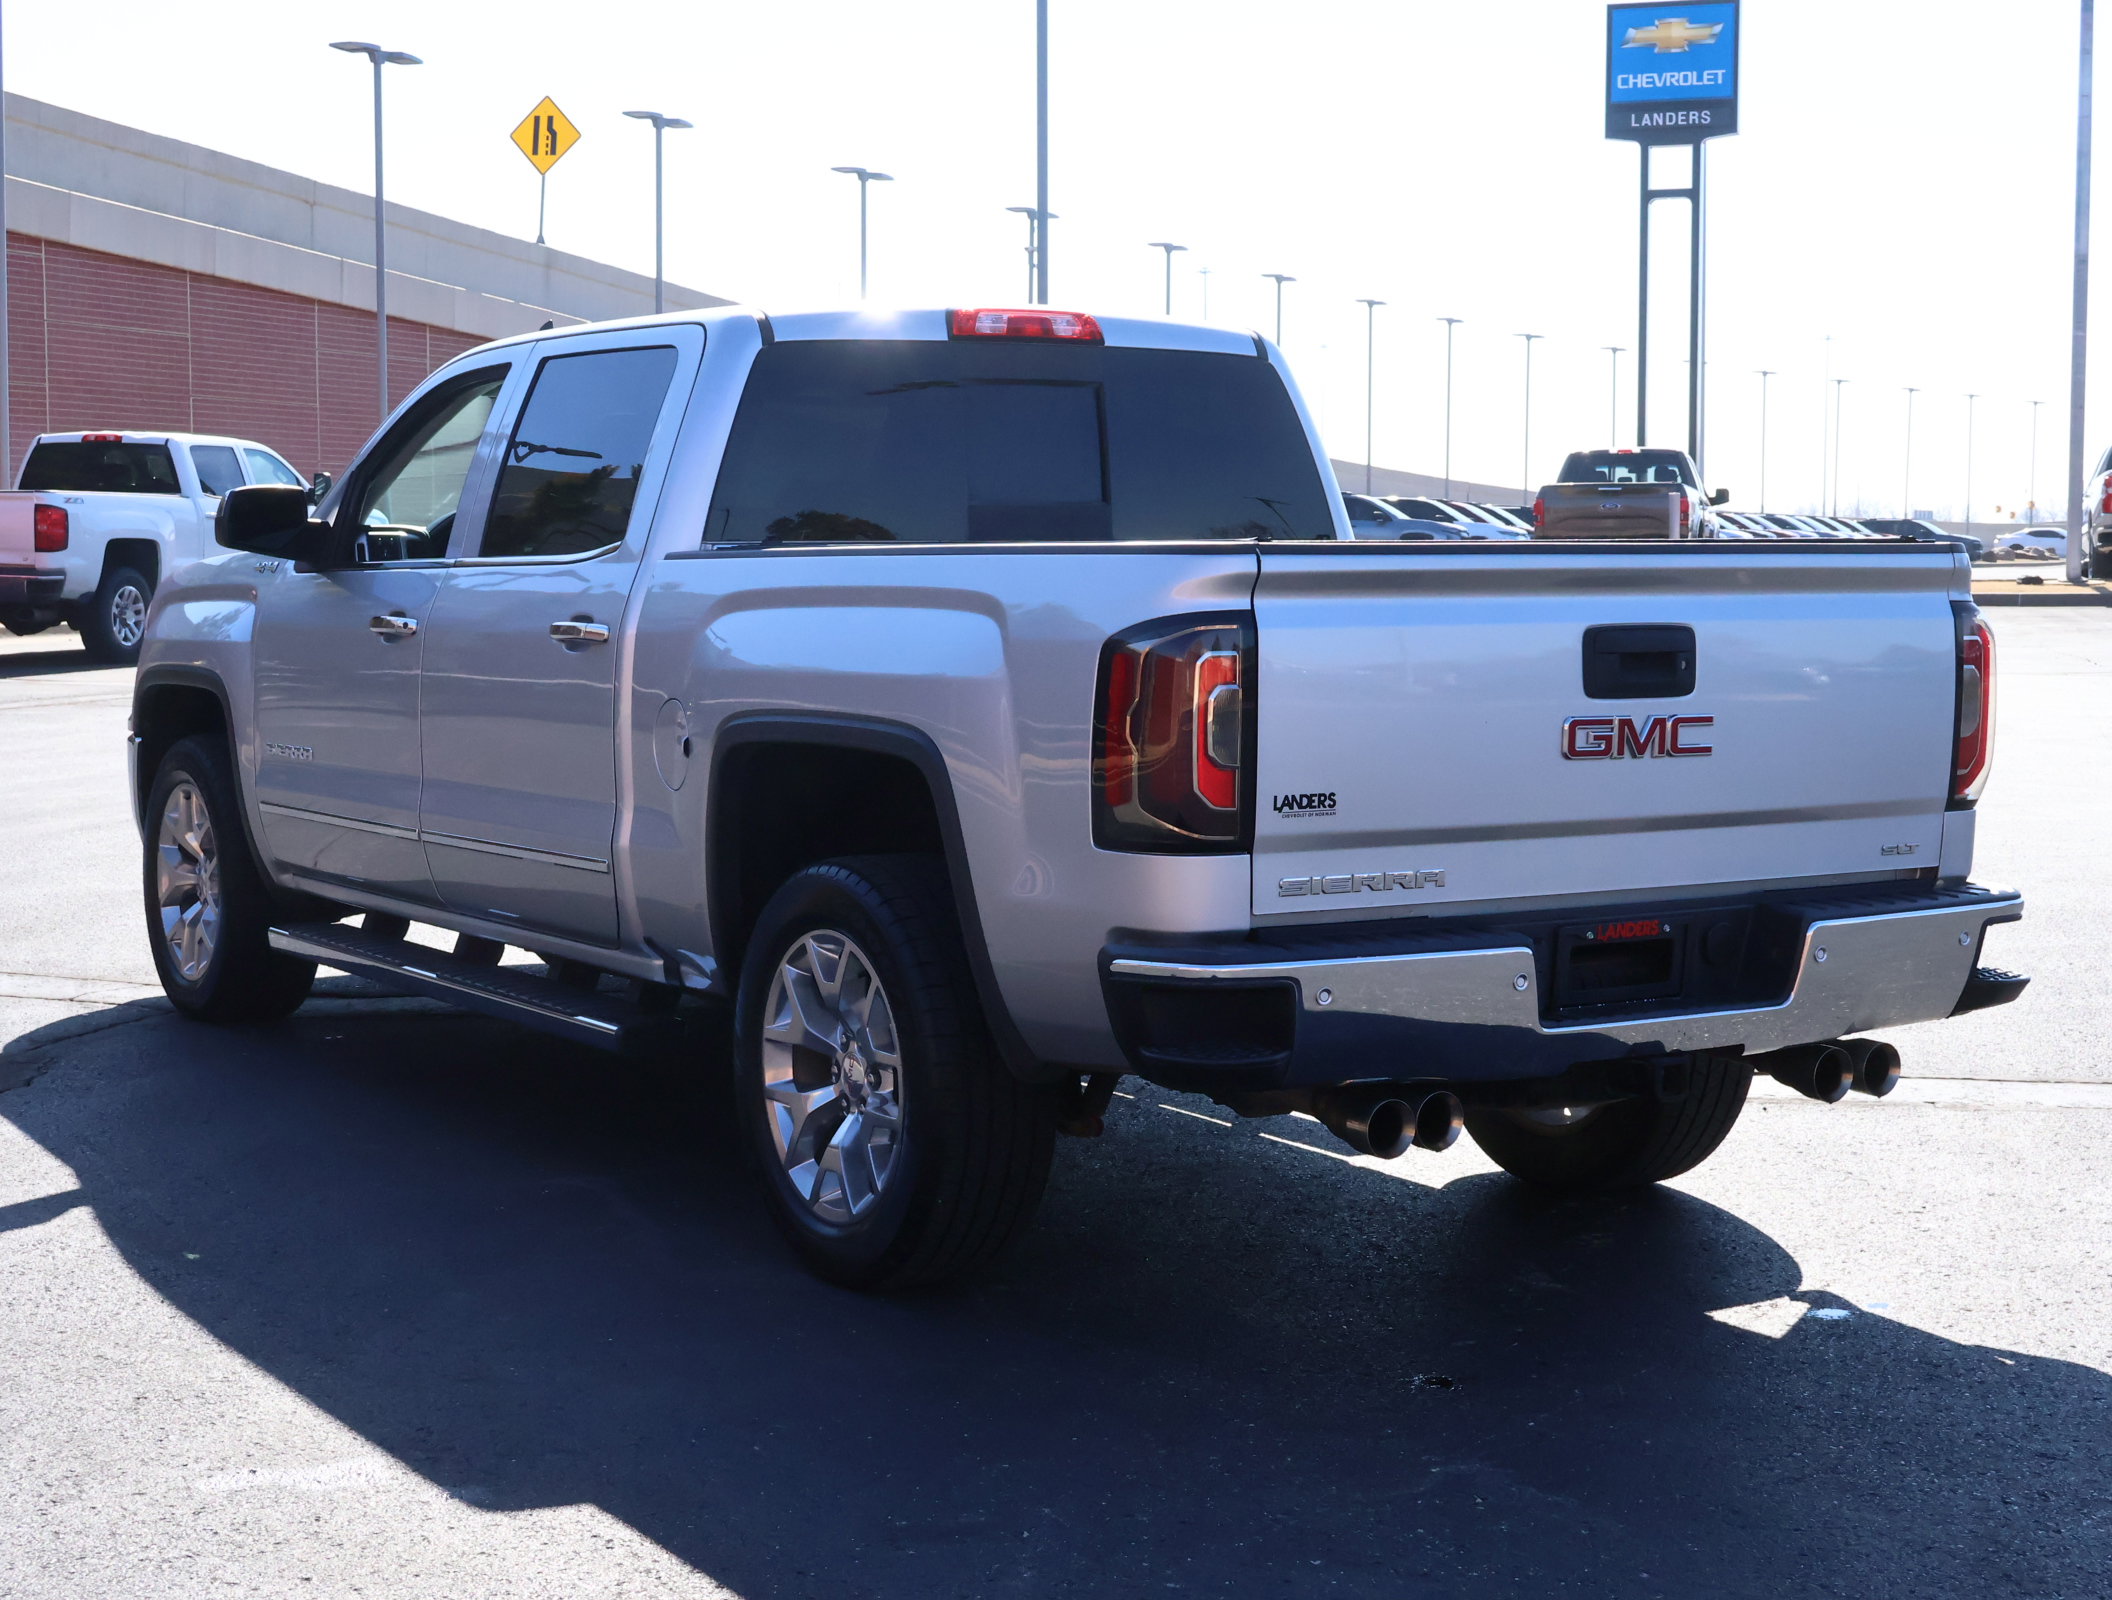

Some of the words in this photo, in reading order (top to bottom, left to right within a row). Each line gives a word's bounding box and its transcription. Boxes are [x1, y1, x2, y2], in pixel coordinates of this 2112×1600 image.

[1617, 69, 1726, 89] CHEVROLET
[1631, 110, 1712, 127] LANDERS
[1561, 714, 1715, 760] GMC
[1273, 791, 1337, 813] LANDERS
[1881, 842, 1920, 856] SLT
[1278, 868, 1446, 898] SIERRA
[1597, 920, 1660, 942] LANDERS
